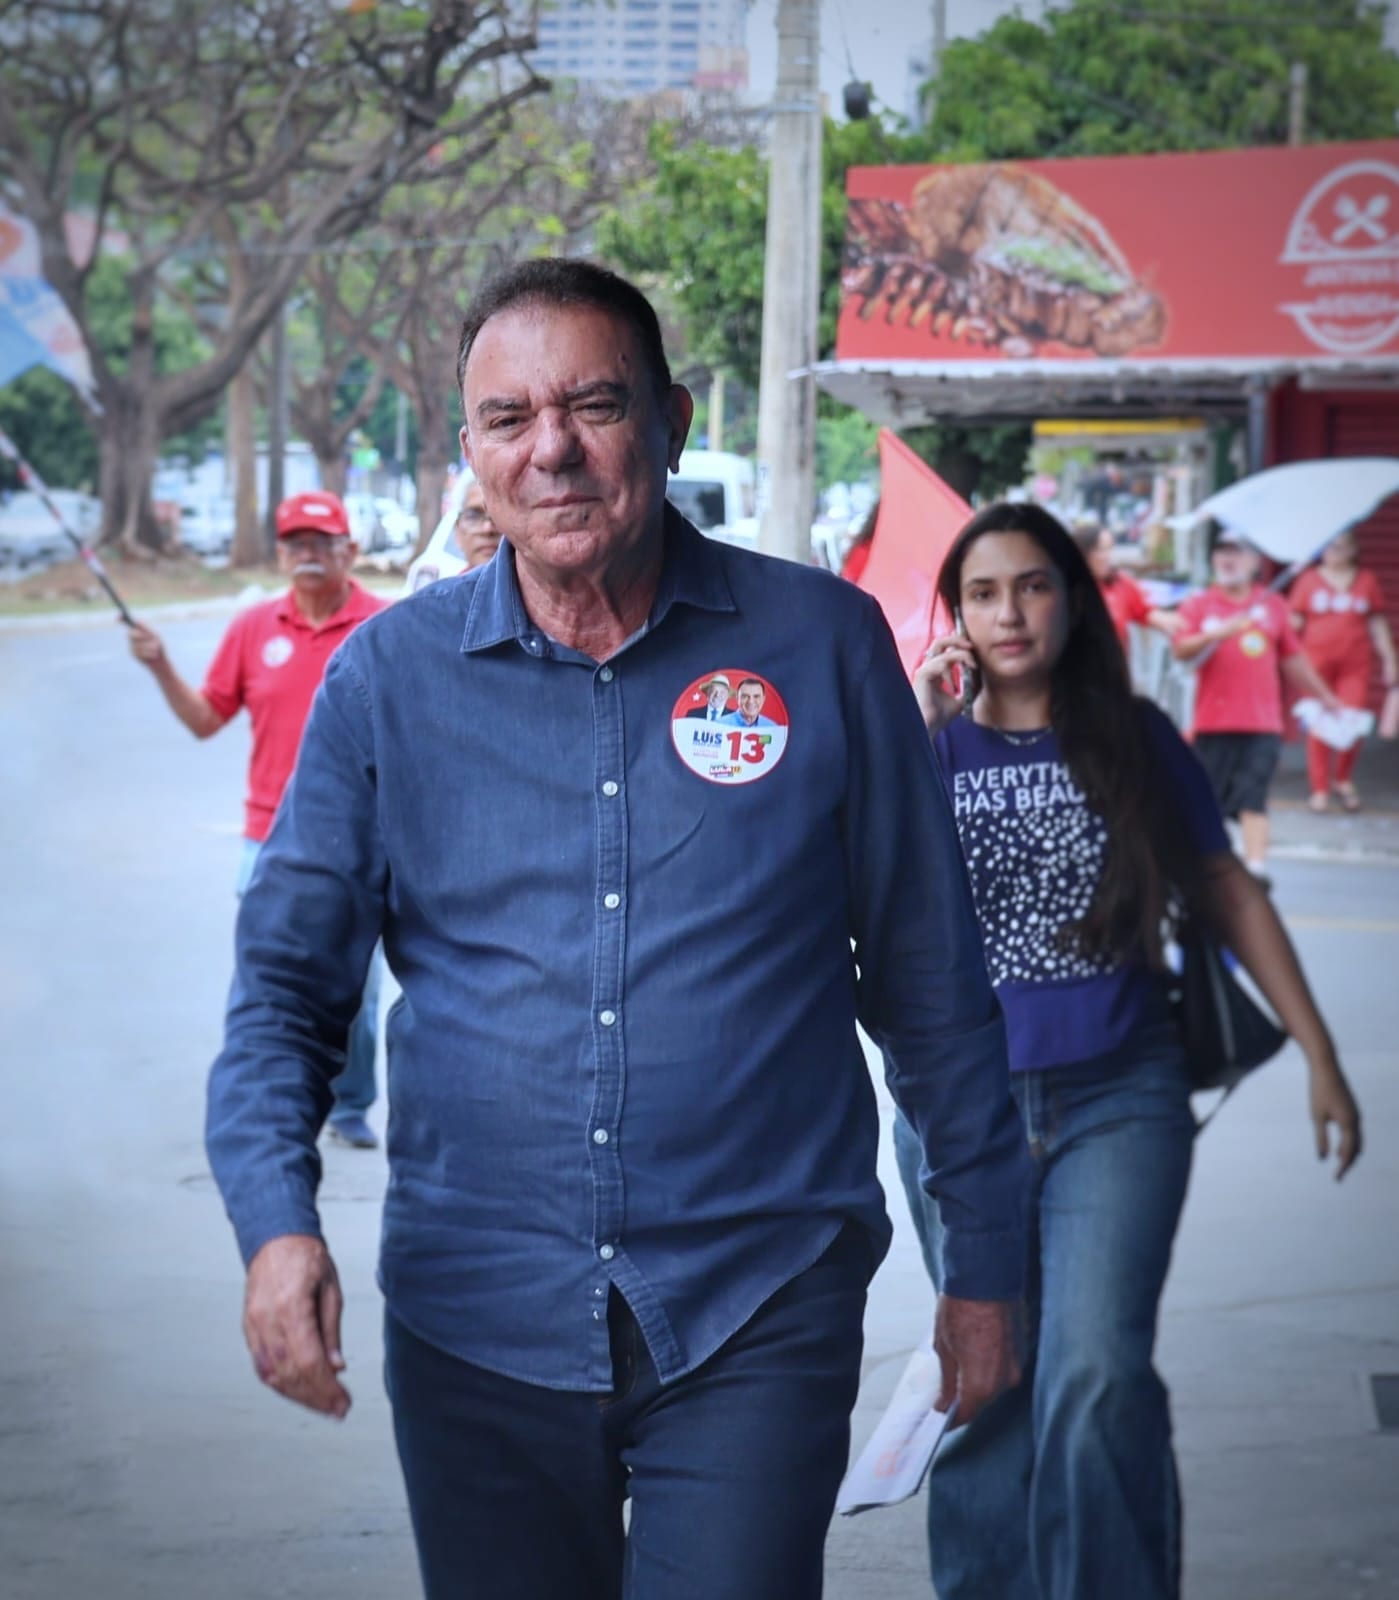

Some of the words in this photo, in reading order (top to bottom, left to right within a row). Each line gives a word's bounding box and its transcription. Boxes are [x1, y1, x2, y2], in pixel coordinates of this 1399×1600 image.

[726, 731, 765, 763] 13
[954, 762, 1069, 794] EVERYTH
[954, 789, 1007, 817] HAS
[1015, 782, 1086, 811] BEAU
